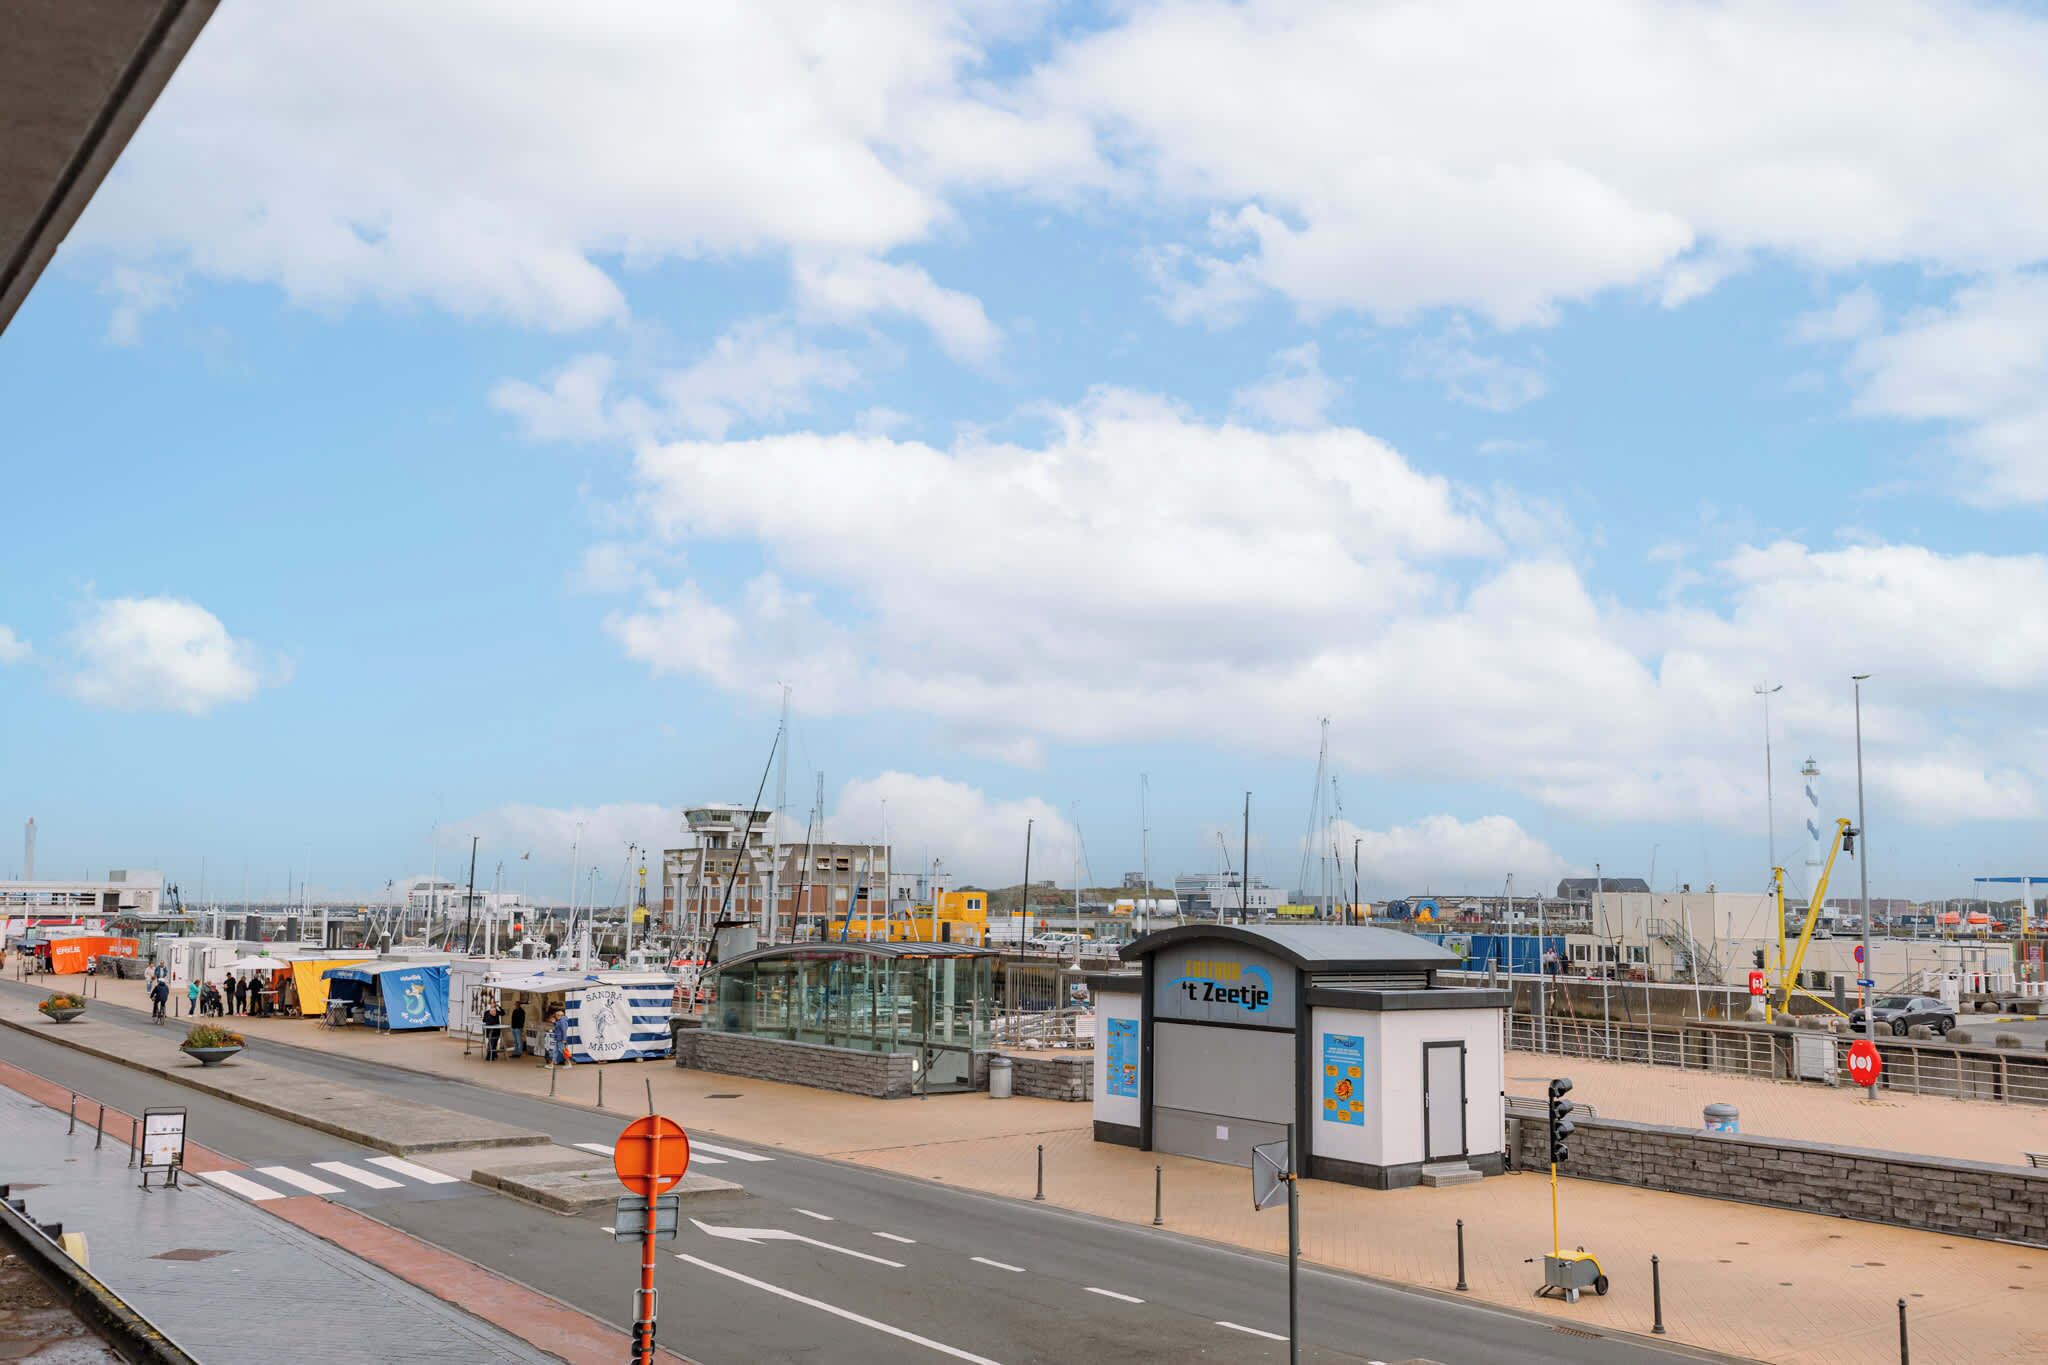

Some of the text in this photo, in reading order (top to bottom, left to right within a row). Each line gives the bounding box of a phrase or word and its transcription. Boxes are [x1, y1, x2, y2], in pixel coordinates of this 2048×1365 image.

[586, 991, 623, 1001] SANDRA
[1203, 982, 1269, 1010] Zeetje
[588, 1041, 624, 1051] MANON
